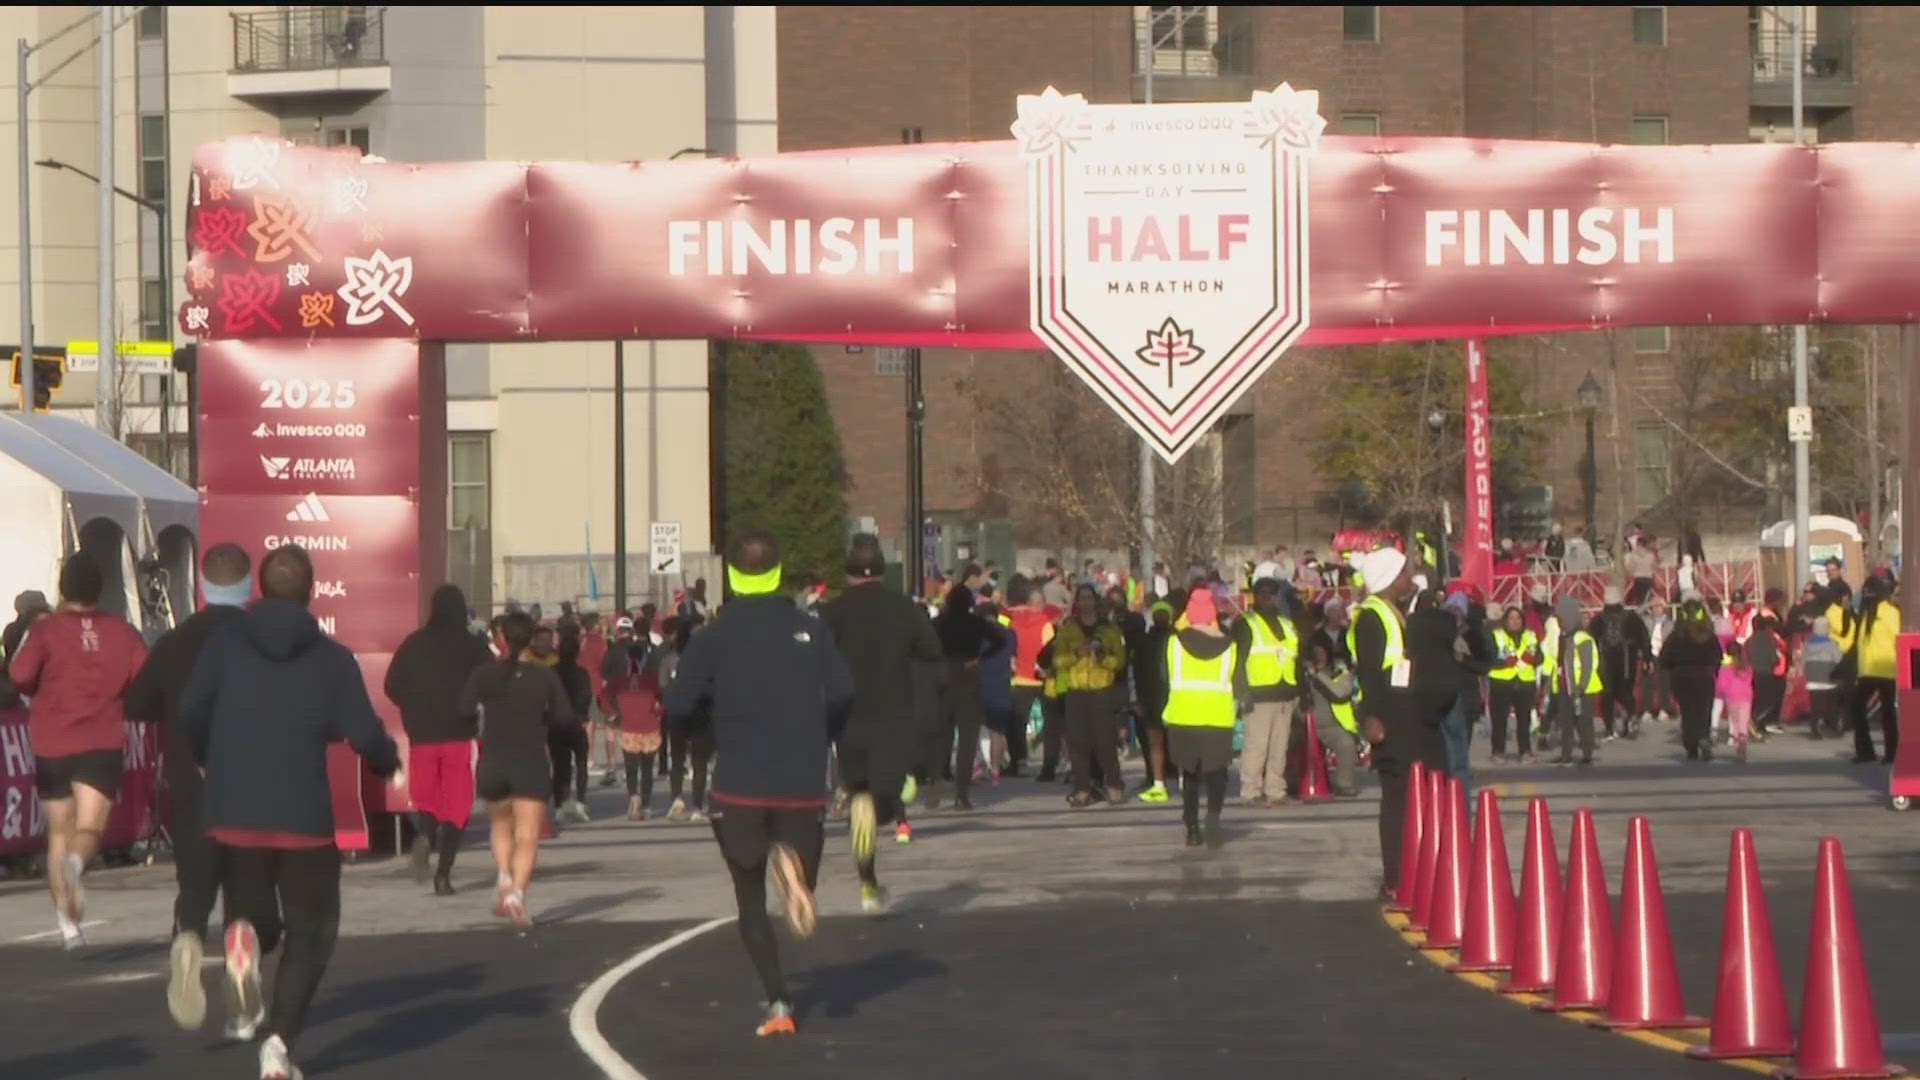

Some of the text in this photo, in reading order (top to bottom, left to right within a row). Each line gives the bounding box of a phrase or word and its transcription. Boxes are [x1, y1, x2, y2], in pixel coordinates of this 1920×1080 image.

[1084, 163, 1246, 177] THANKSGIVING
[1145, 185, 1184, 198] DAY
[1088, 214, 1250, 262] HALF
[1425, 207, 1674, 266] FINISH
[669, 217, 914, 275] FINISH
[1107, 280, 1224, 295] MARATHON
[260, 379, 356, 409] 2025
[276, 422, 366, 438] Invesco QQQ
[293, 458, 356, 473] ATLANTA
[655, 526, 676, 535] STOP
[263, 535, 348, 551] GARMIN
